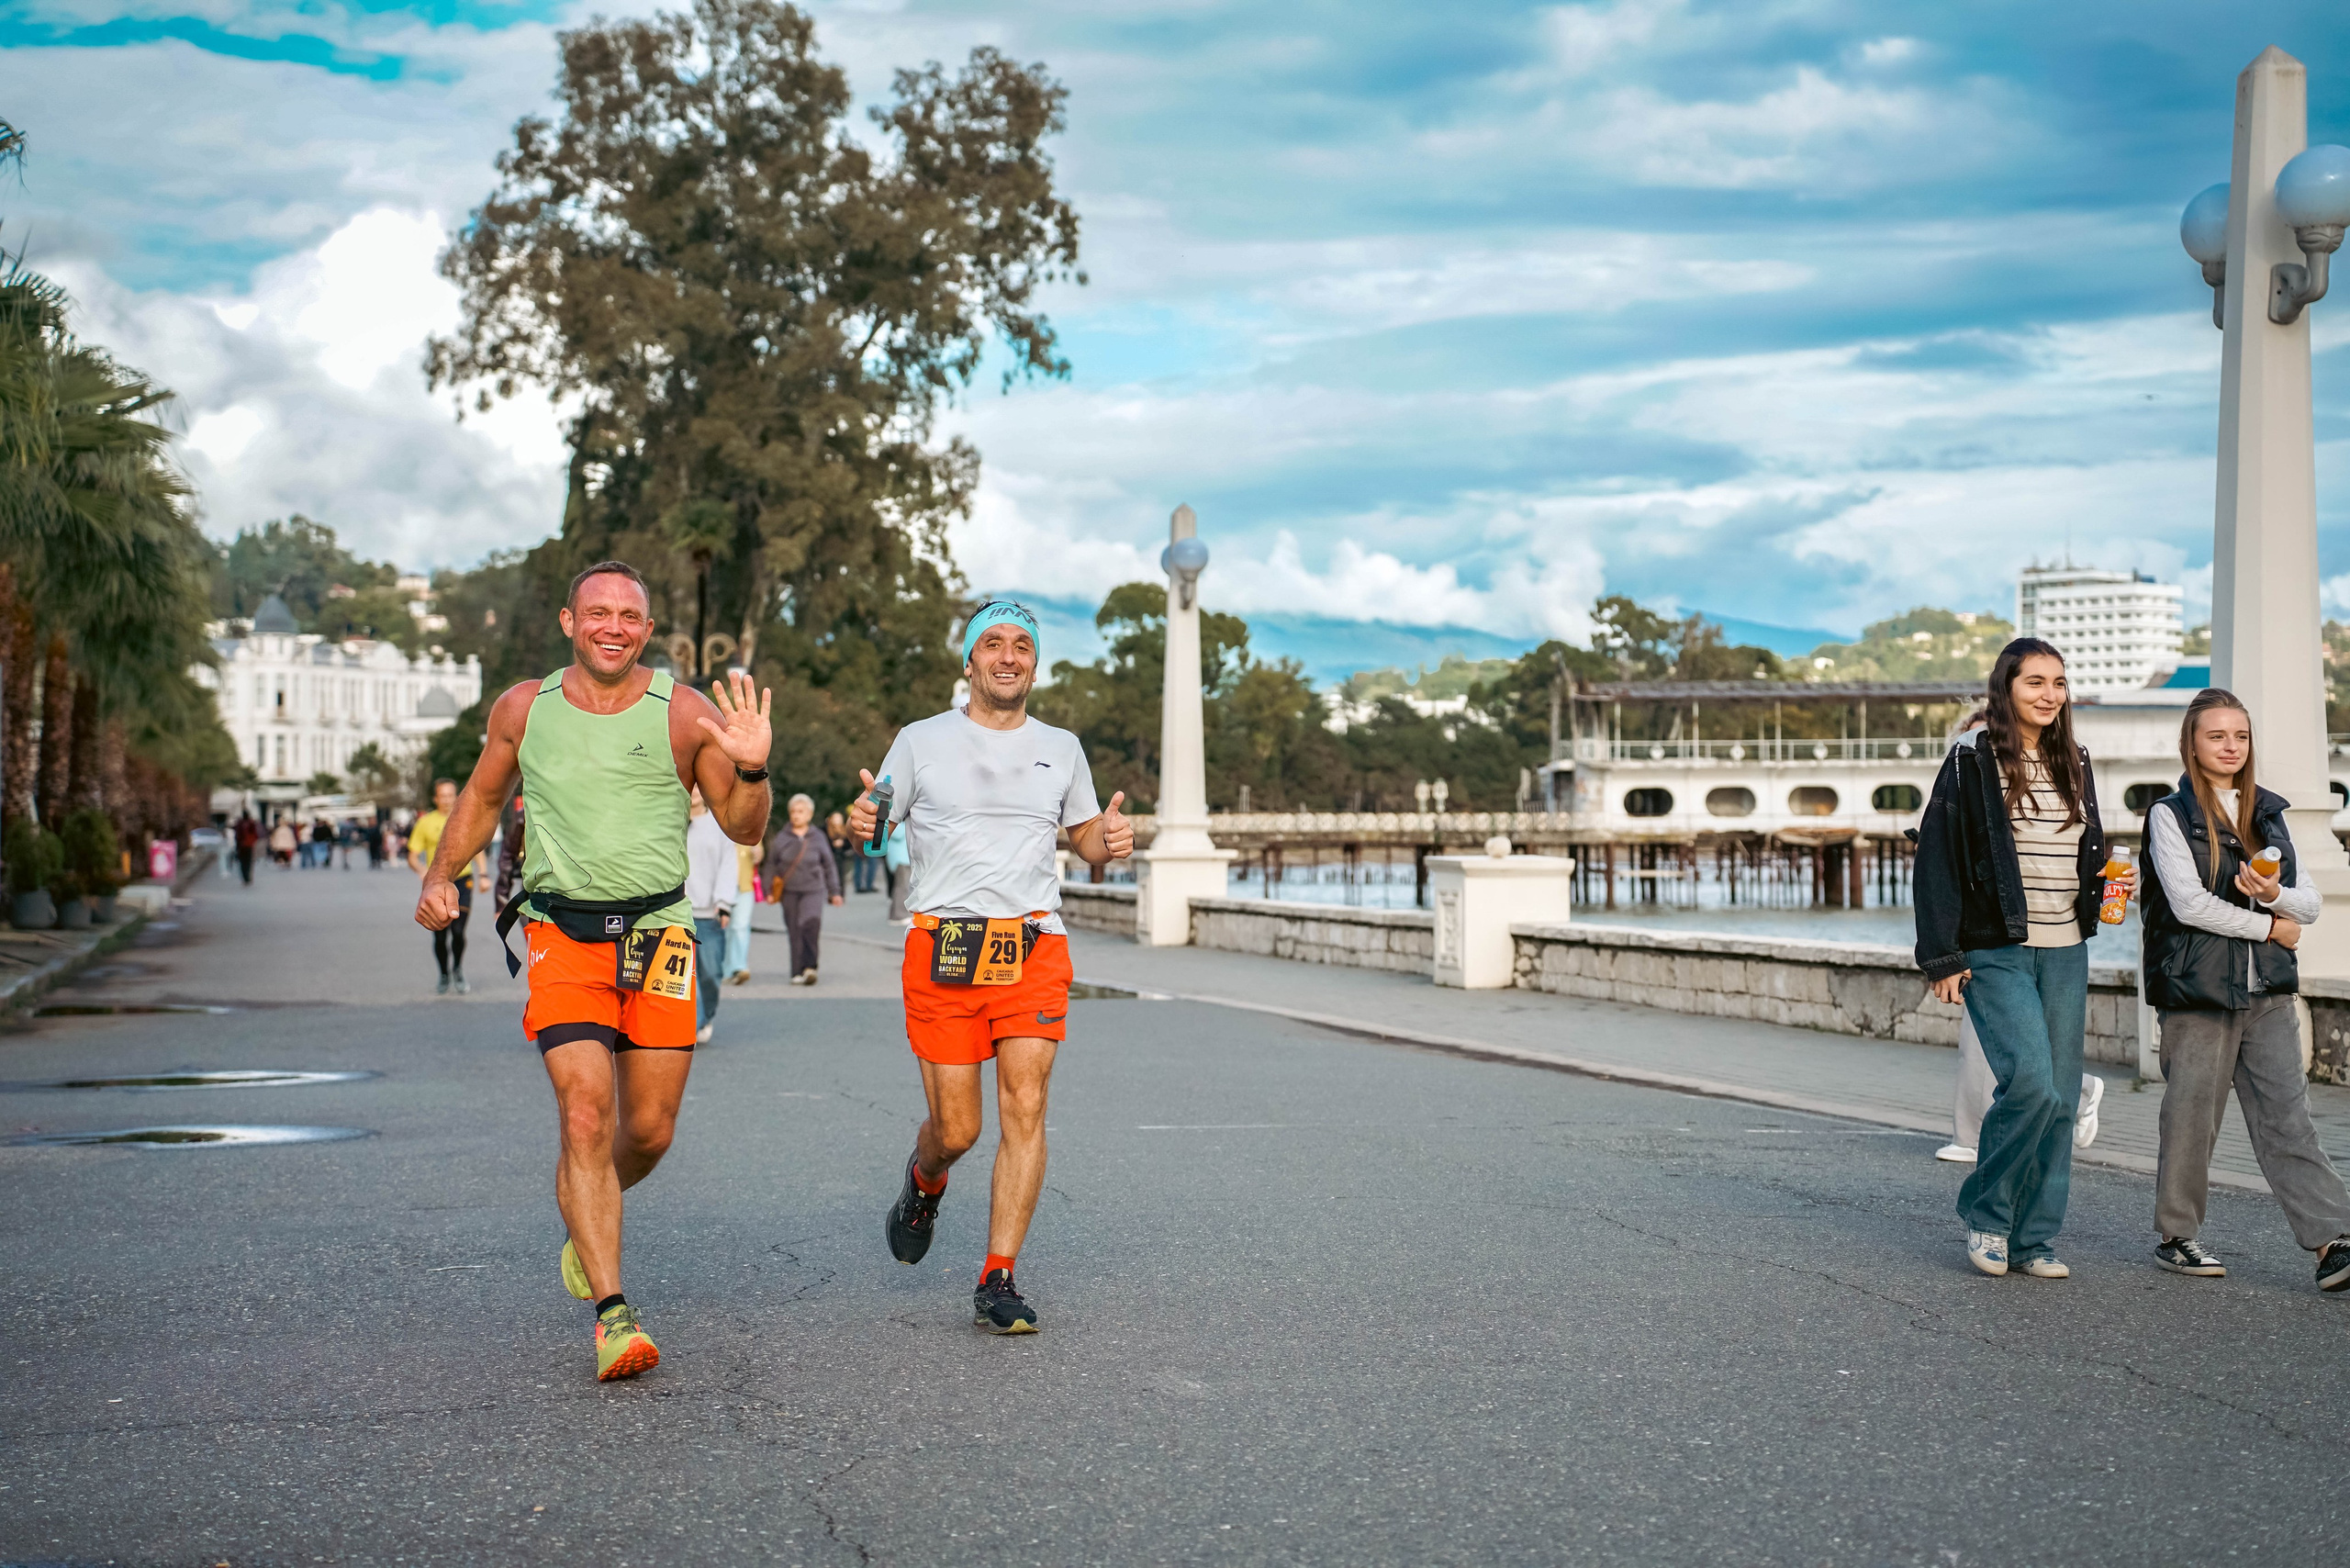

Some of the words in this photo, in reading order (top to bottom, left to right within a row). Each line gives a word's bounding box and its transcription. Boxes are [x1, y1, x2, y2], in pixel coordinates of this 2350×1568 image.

[665, 938, 681, 948] Hard
[682, 942, 690, 950] Run
[990, 940, 1017, 964] 29
[665, 955, 686, 977] 41
[940, 956, 967, 965] WORLD
